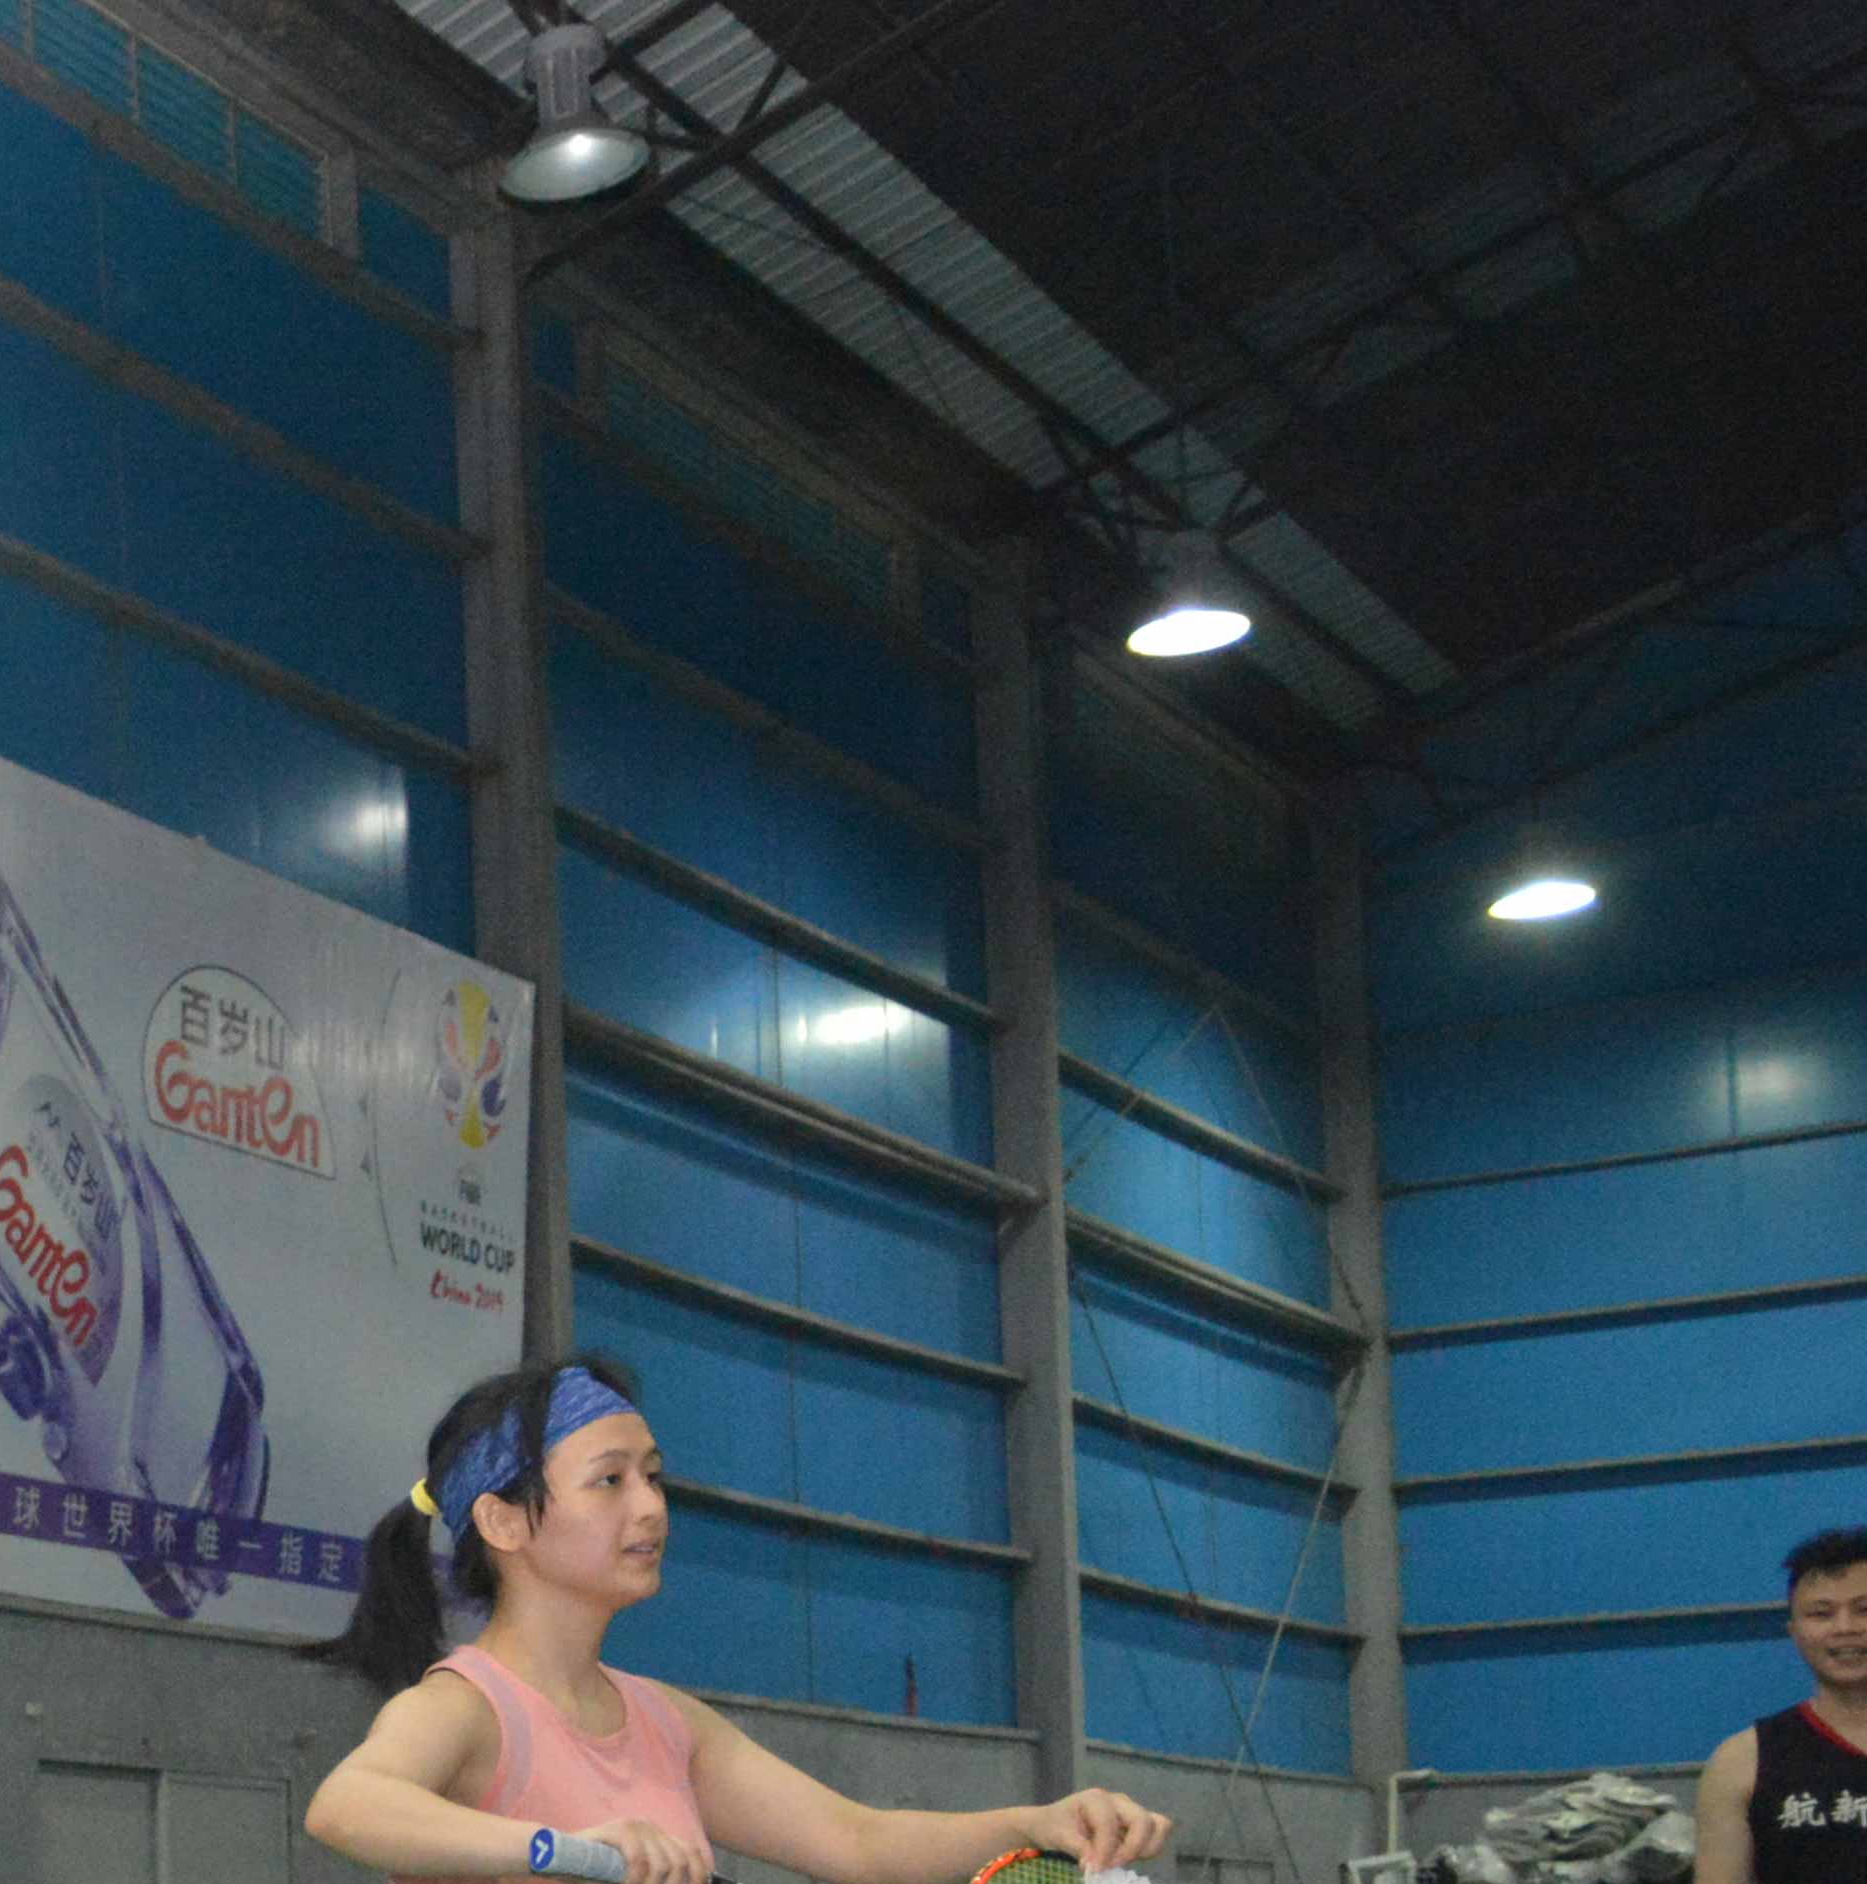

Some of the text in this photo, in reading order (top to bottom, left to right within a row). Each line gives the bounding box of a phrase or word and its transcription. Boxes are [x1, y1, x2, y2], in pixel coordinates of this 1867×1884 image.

[181, 985, 284, 1070] 百岁山
[155, 1040, 320, 1168] Ganten
[420, 1221, 515, 1273] WORLD CUP
